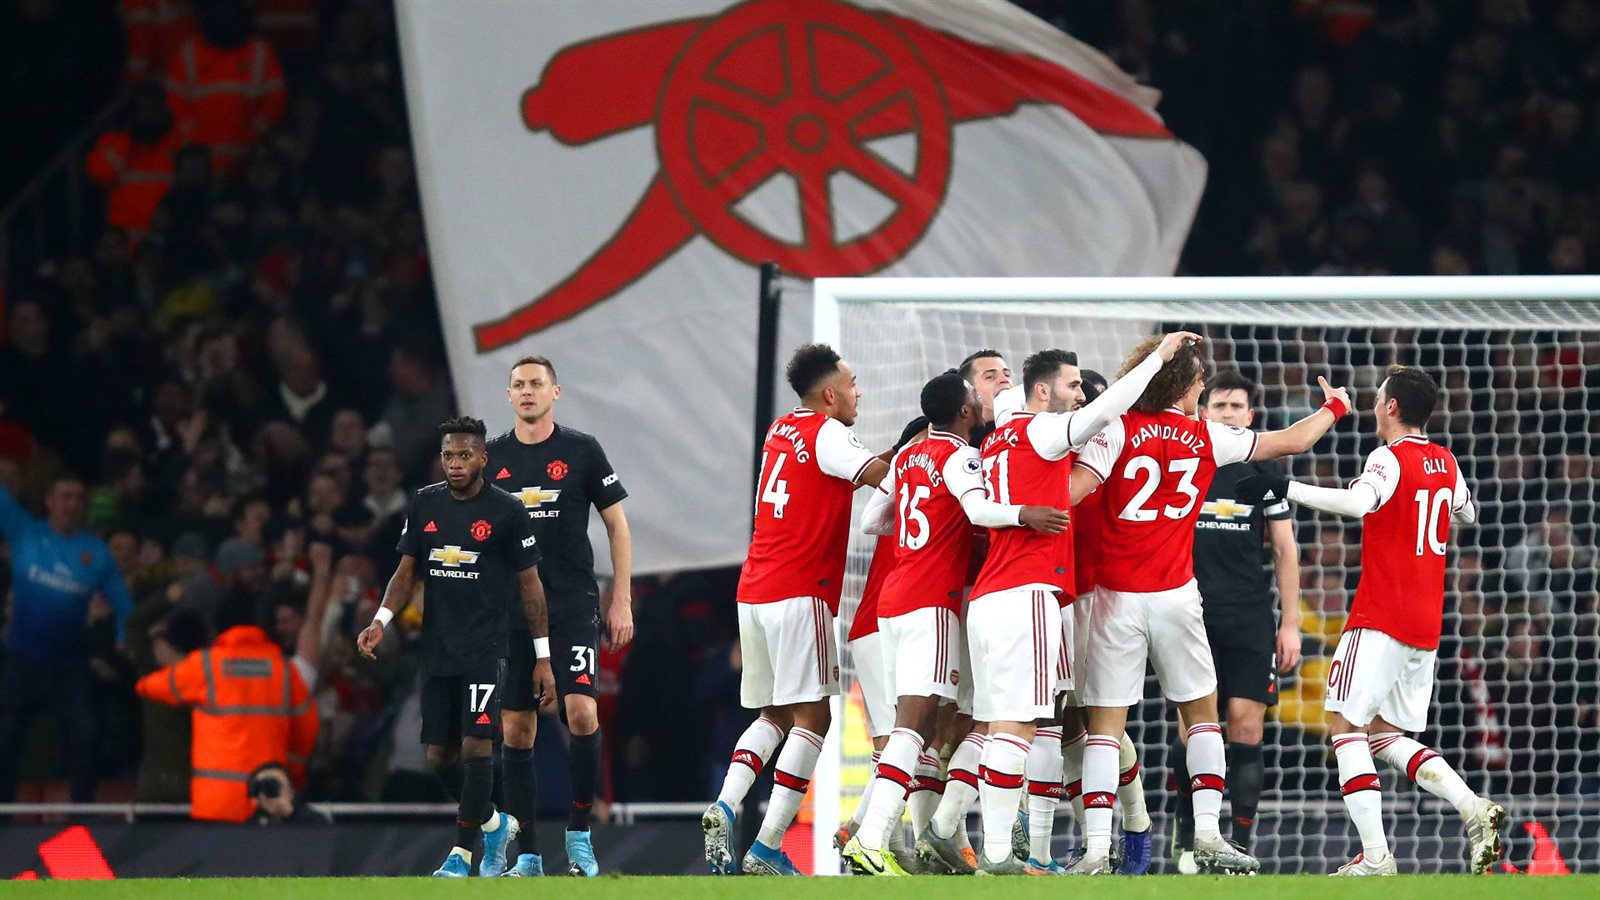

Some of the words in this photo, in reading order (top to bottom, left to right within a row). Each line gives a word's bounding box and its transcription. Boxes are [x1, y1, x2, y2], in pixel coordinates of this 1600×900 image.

[754, 451, 791, 519] 14
[899, 482, 931, 551] 15
[1117, 454, 1201, 522] 23
[1195, 520, 1252, 532] CHEVROLET
[1414, 486, 1453, 556] 10
[569, 645, 595, 675] 31
[468, 683, 496, 712] 17
